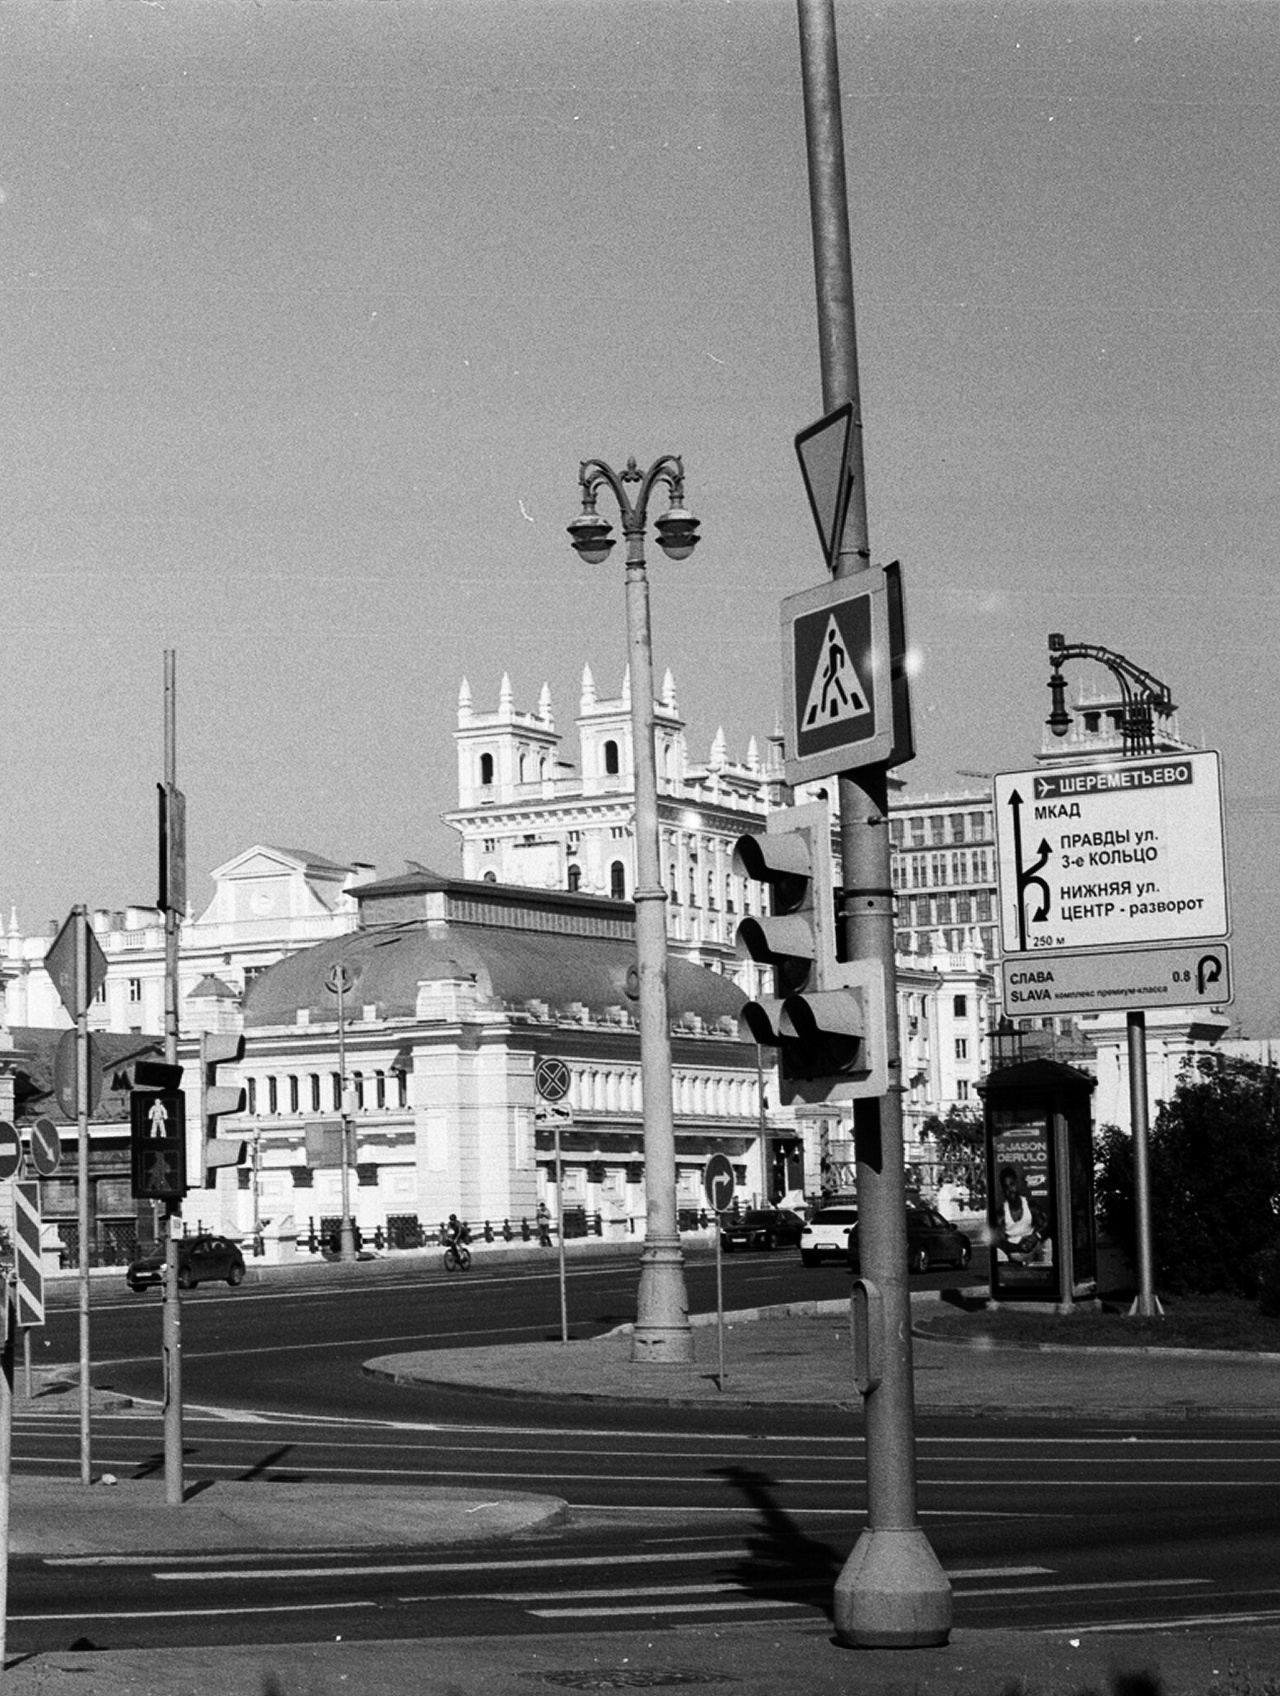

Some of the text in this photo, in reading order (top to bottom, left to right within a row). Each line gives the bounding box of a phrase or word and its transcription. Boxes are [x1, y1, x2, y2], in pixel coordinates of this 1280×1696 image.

[1059, 766, 1189, 793] ШЕРЕМЕТЬЕВО
[1034, 803, 1081, 820] МКАД
[1060, 830, 1159, 849] ПРАВДЫ ул.
[1061, 846, 1158, 868] 3-е КОЛЬЦО
[1060, 881, 1160, 900] НИЖНЯЯ ул.
[1061, 902, 1115, 922] ЦЕНТР
[1129, 898, 1205, 917] разворот
[1033, 936, 1065, 947] 250 м
[1009, 971, 1055, 985] СЛАВА
[1172, 970, 1191, 983] 0.8
[1010, 989, 1052, 1002] SLAVA
[1054, 990, 1096, 999] комплекс
[1006, 1142, 1046, 1152] JASON
[996, 1152, 1047, 1162] DERULO
